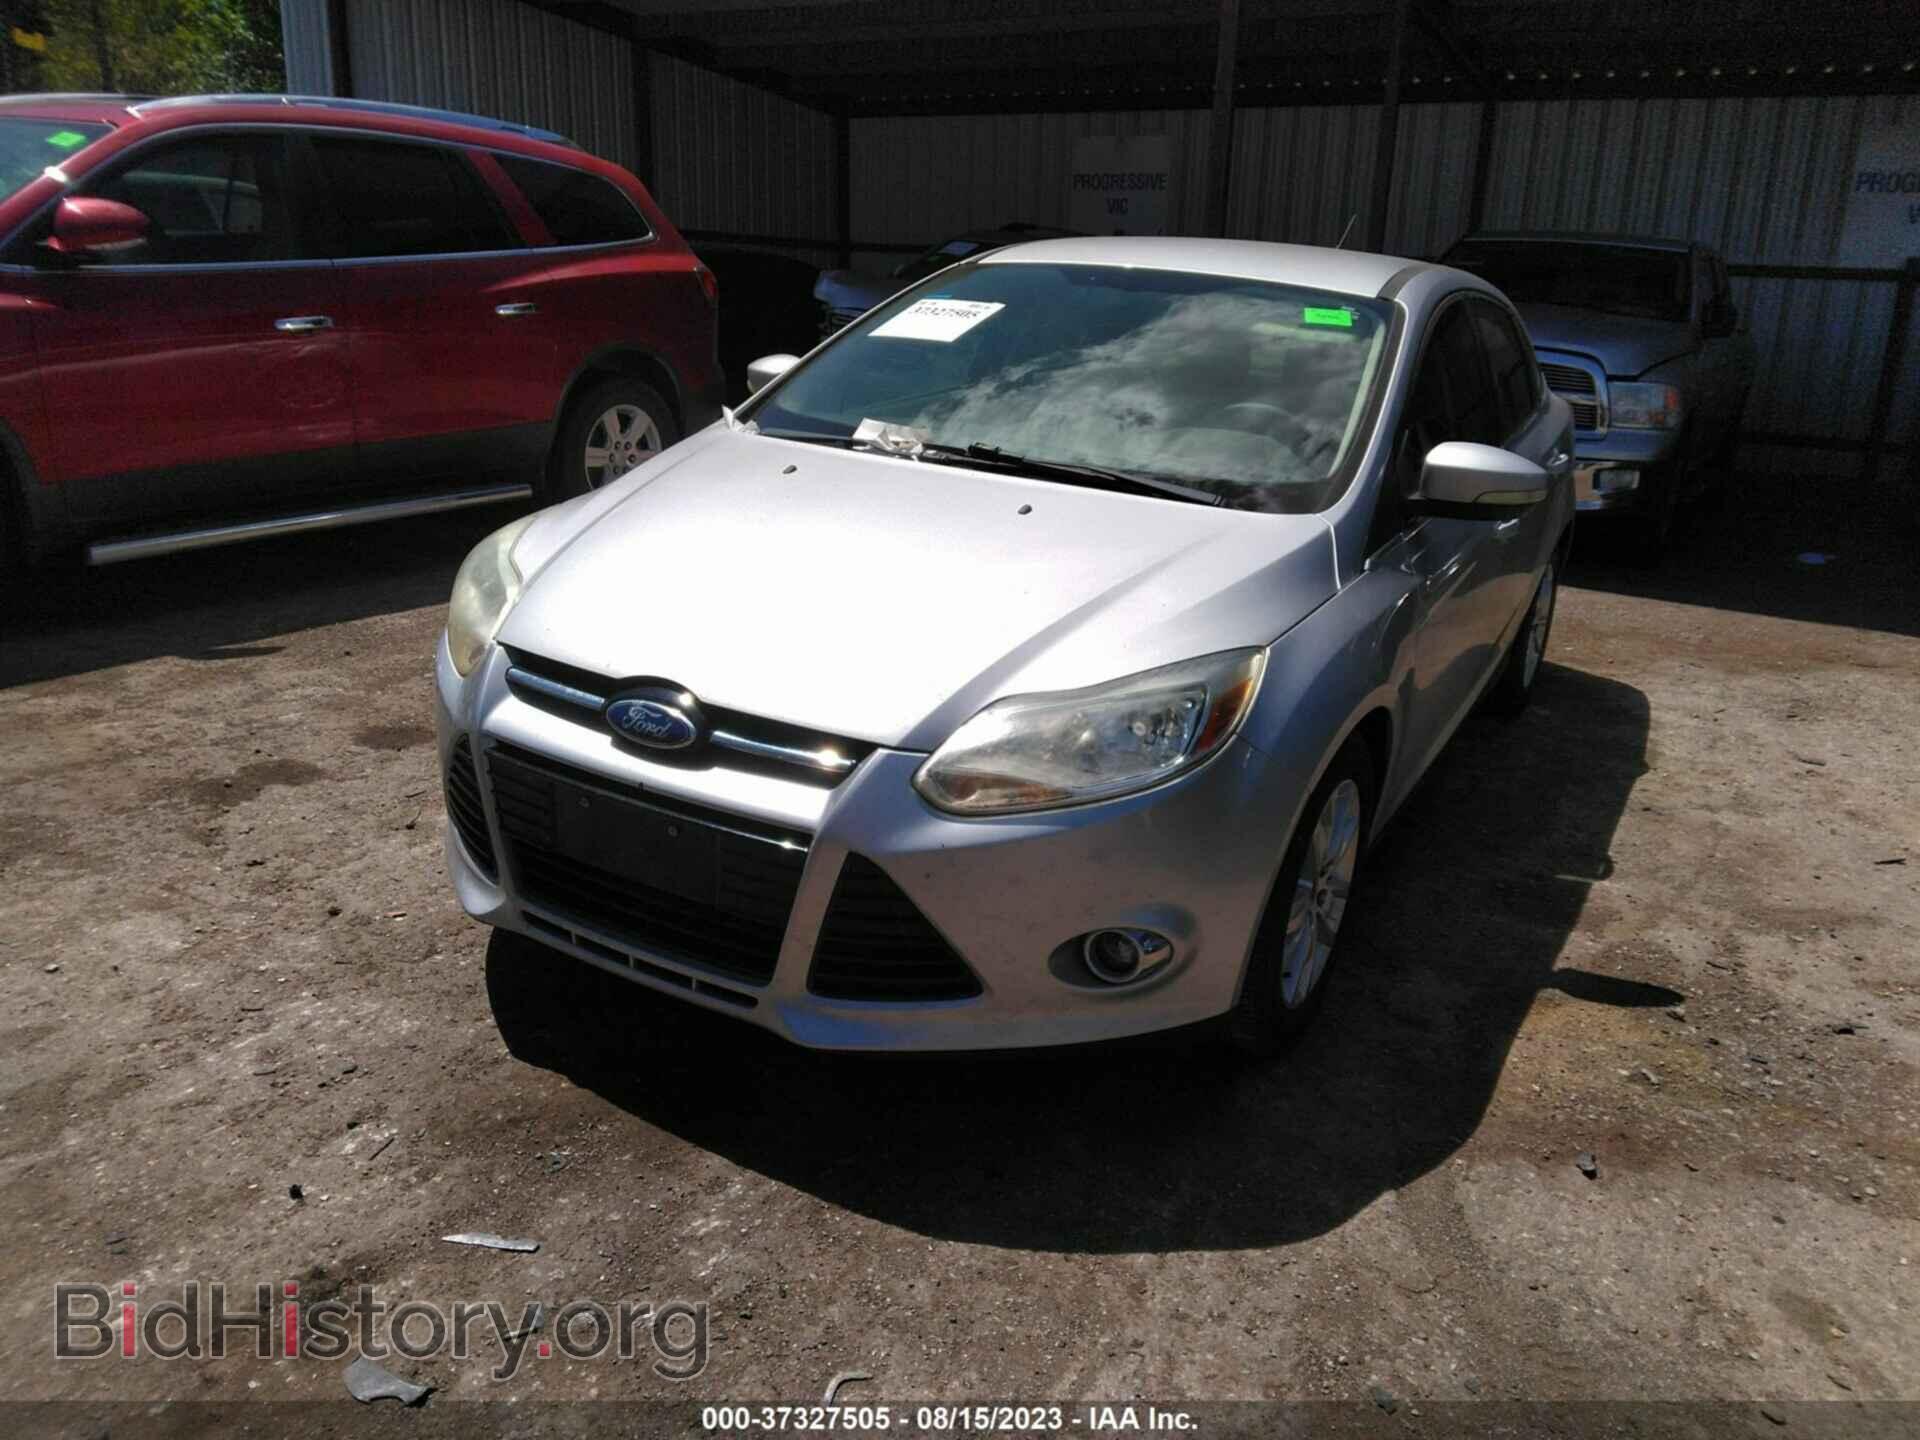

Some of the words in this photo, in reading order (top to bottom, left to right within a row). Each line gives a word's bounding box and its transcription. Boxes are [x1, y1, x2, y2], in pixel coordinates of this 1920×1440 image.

[1073, 173, 1168, 190] PROGRESSIVE
[1855, 172, 1920, 191] PROG
[623, 705, 673, 737] Ford
